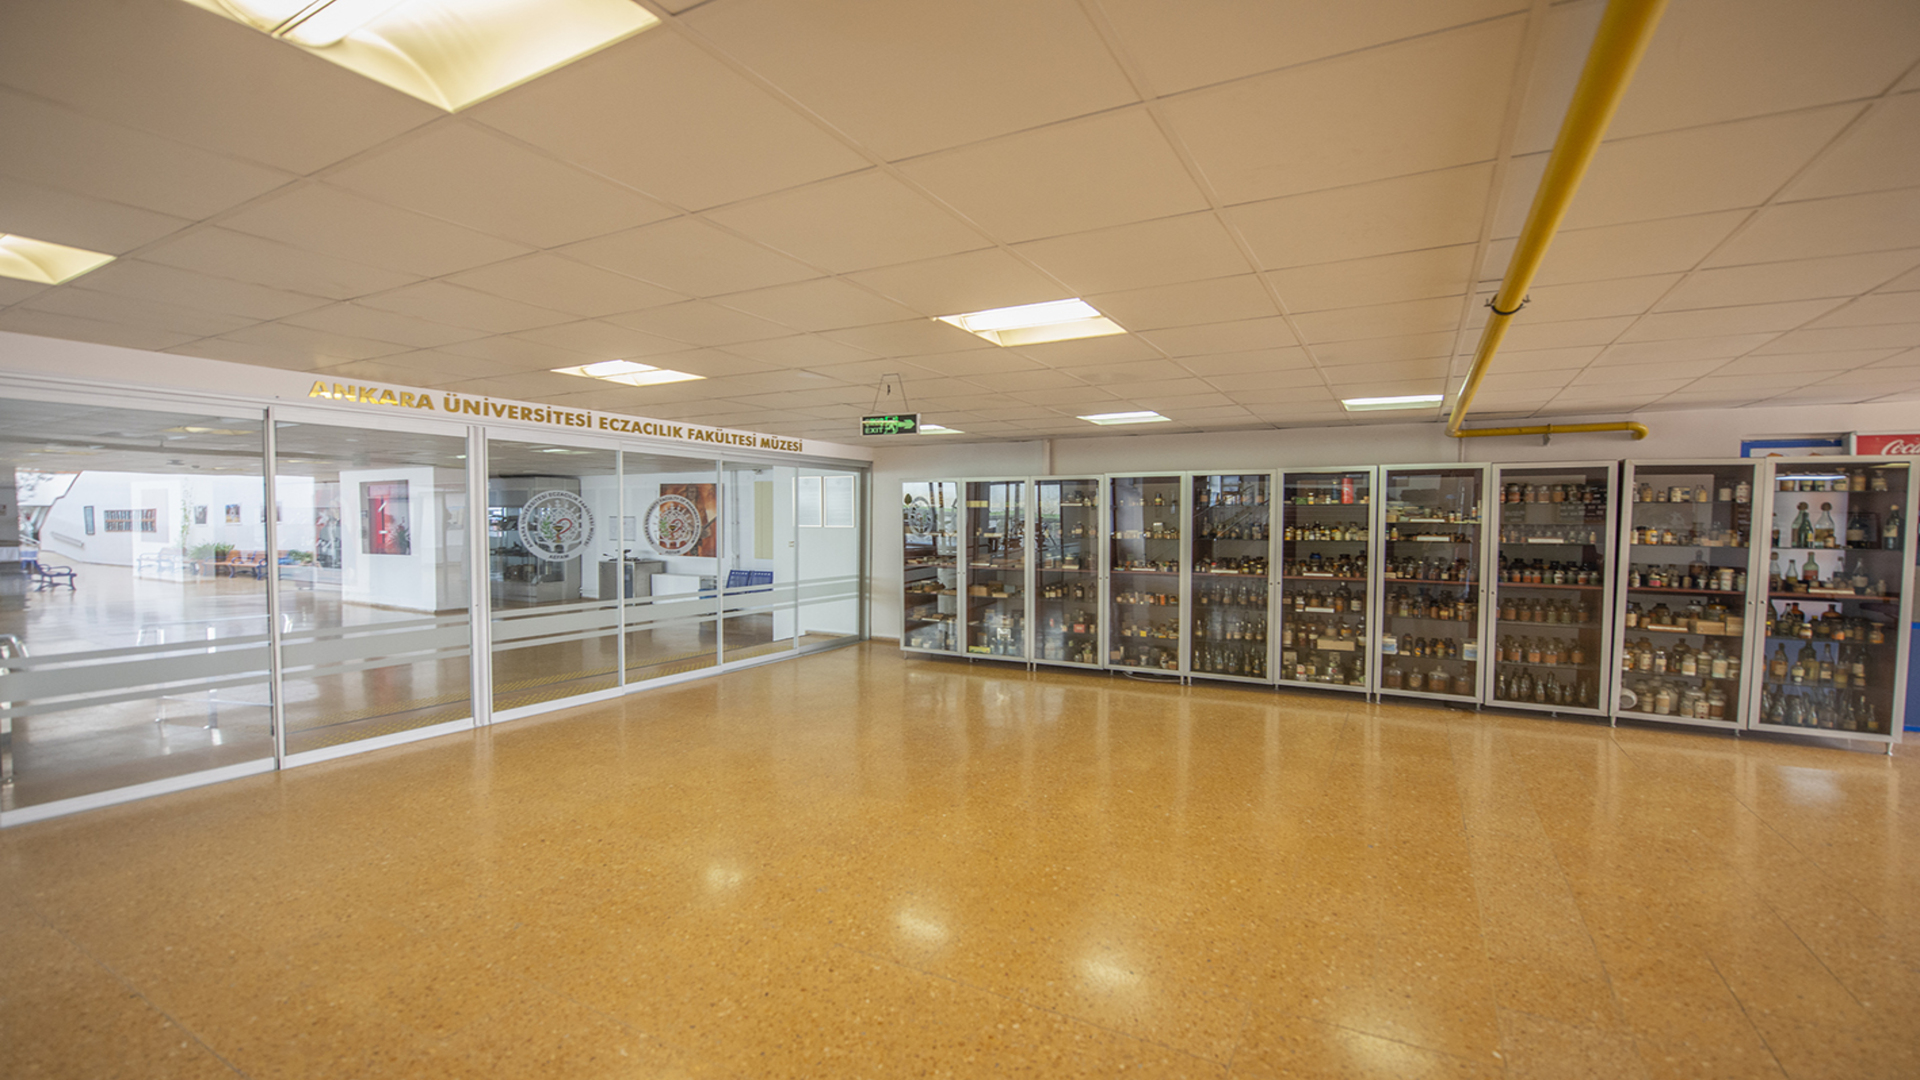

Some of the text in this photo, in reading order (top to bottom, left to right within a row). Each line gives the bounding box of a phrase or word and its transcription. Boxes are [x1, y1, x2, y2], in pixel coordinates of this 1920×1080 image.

[308, 380, 803, 453] ANKARA ÜNİVERSİTESİ ECZACILIK FAKÜLTESİ MÜZESİ
